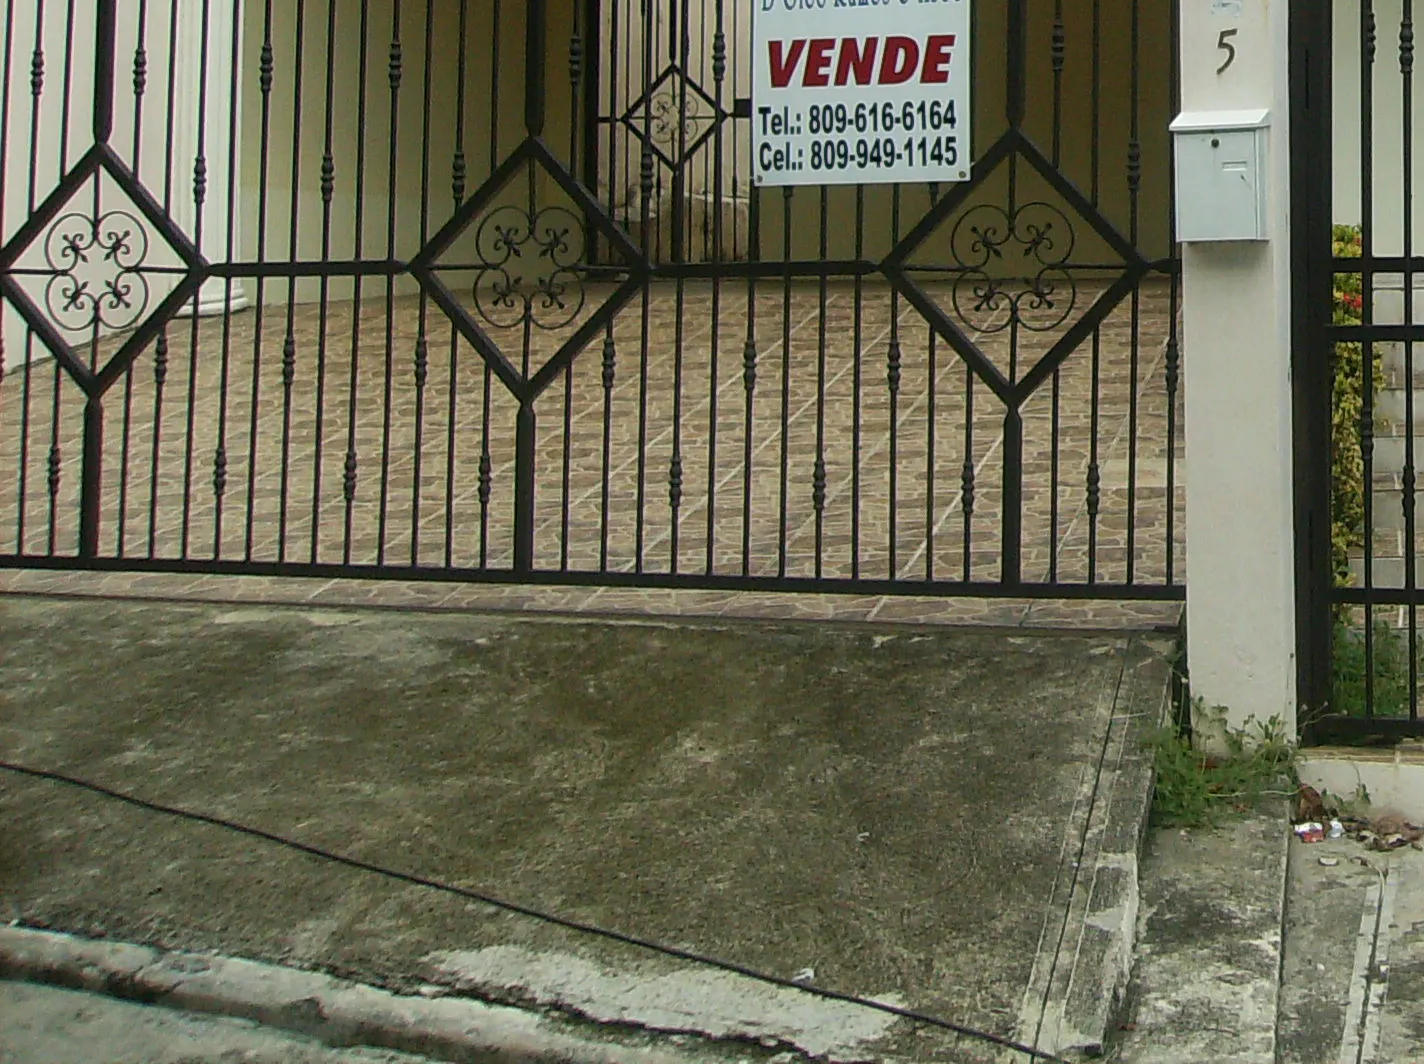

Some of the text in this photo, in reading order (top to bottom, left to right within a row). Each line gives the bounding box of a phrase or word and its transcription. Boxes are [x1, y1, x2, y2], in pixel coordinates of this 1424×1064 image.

[767, 34, 957, 89] VENDE
[1216, 28, 1239, 75] 5
[757, 99, 957, 136] Tel.: 809-616-6164
[758, 136, 958, 172] Cel.: 809-949-1145
